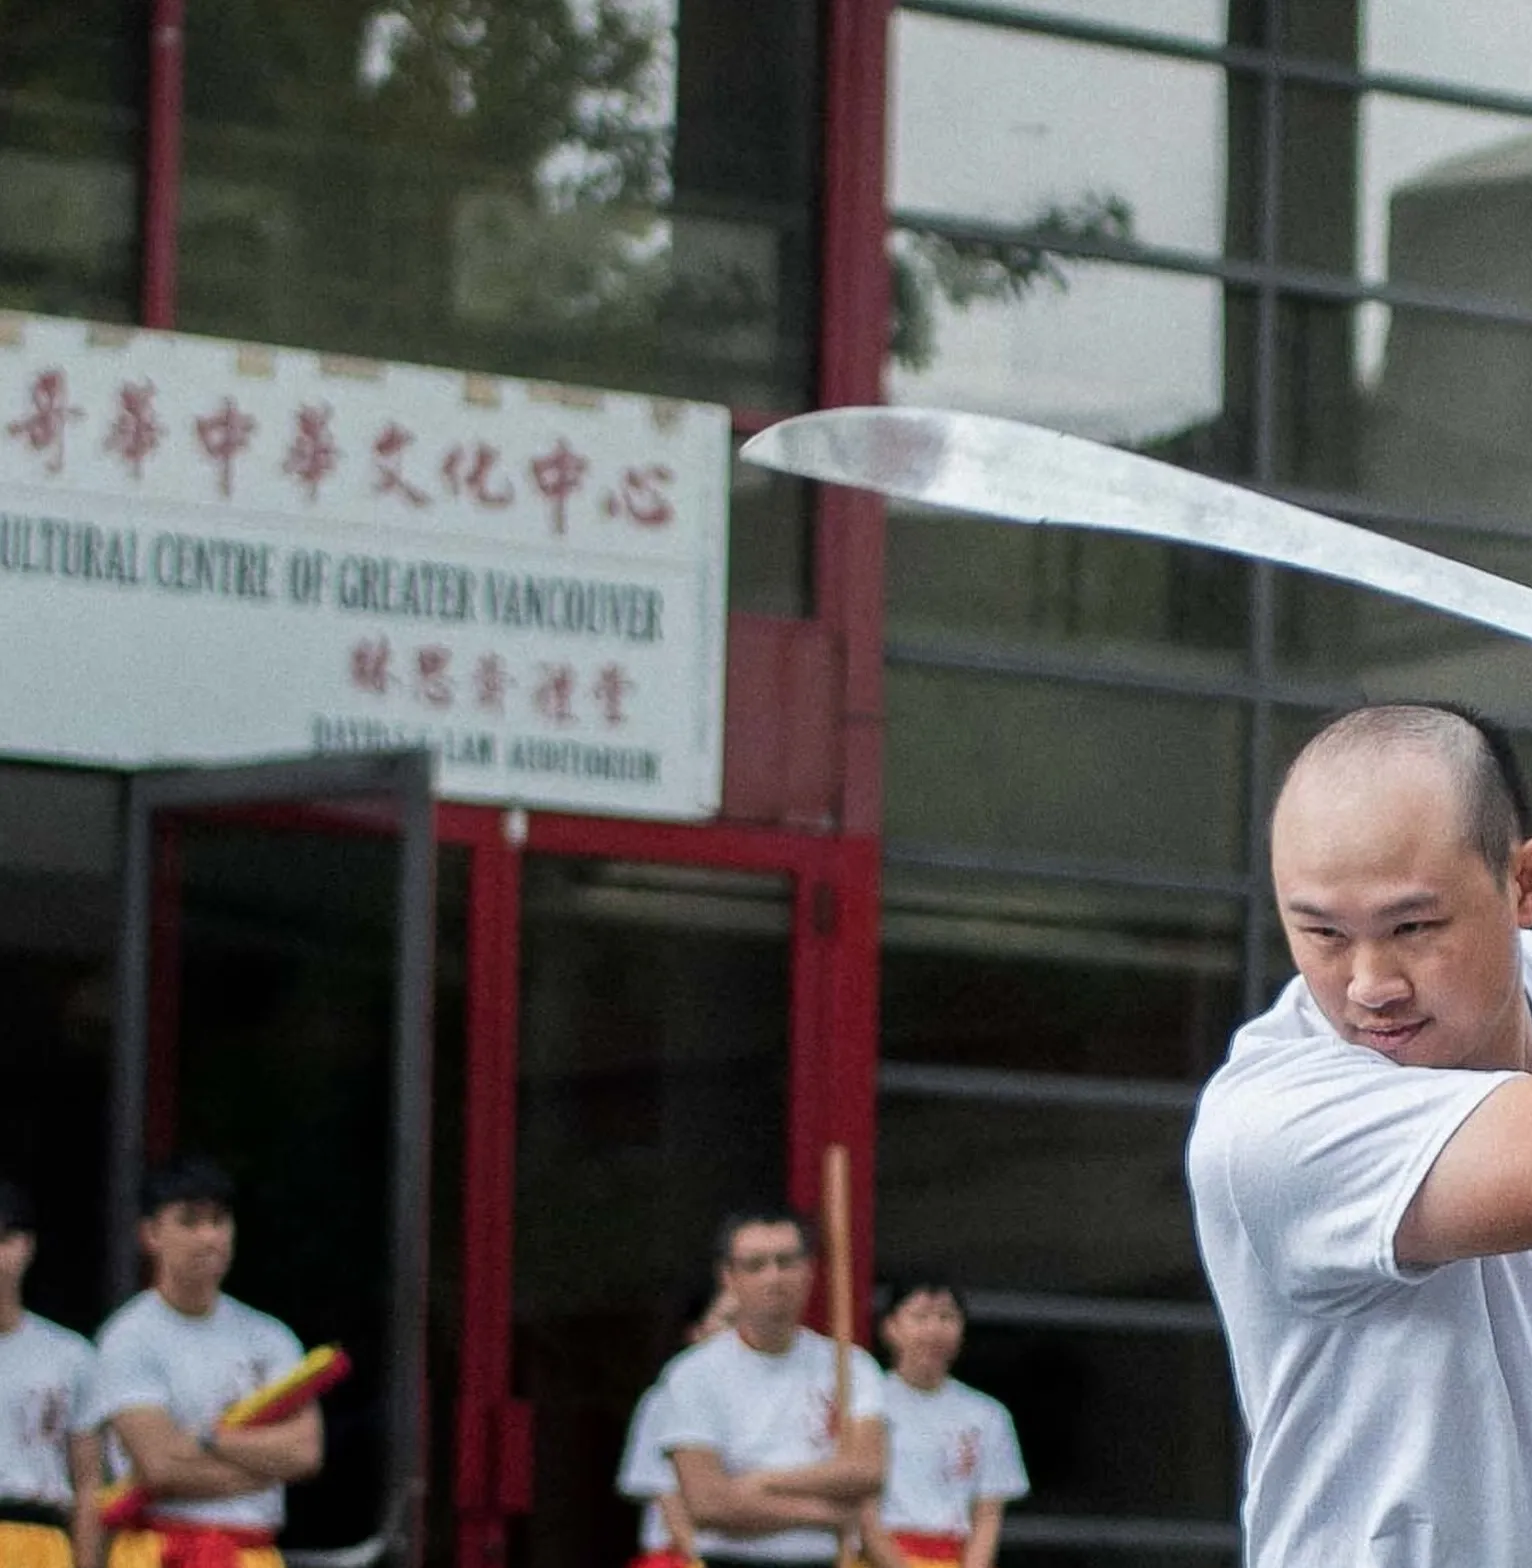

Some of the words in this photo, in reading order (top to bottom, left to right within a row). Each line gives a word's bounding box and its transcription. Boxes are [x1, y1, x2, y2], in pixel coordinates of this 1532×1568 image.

[154, 531, 272, 600] CENTRE
[290, 549, 328, 604] OF
[338, 554, 479, 621] GREATER
[484, 570, 664, 642] VANCOUVER
[512, 735, 661, 783] AUDITORIUM
